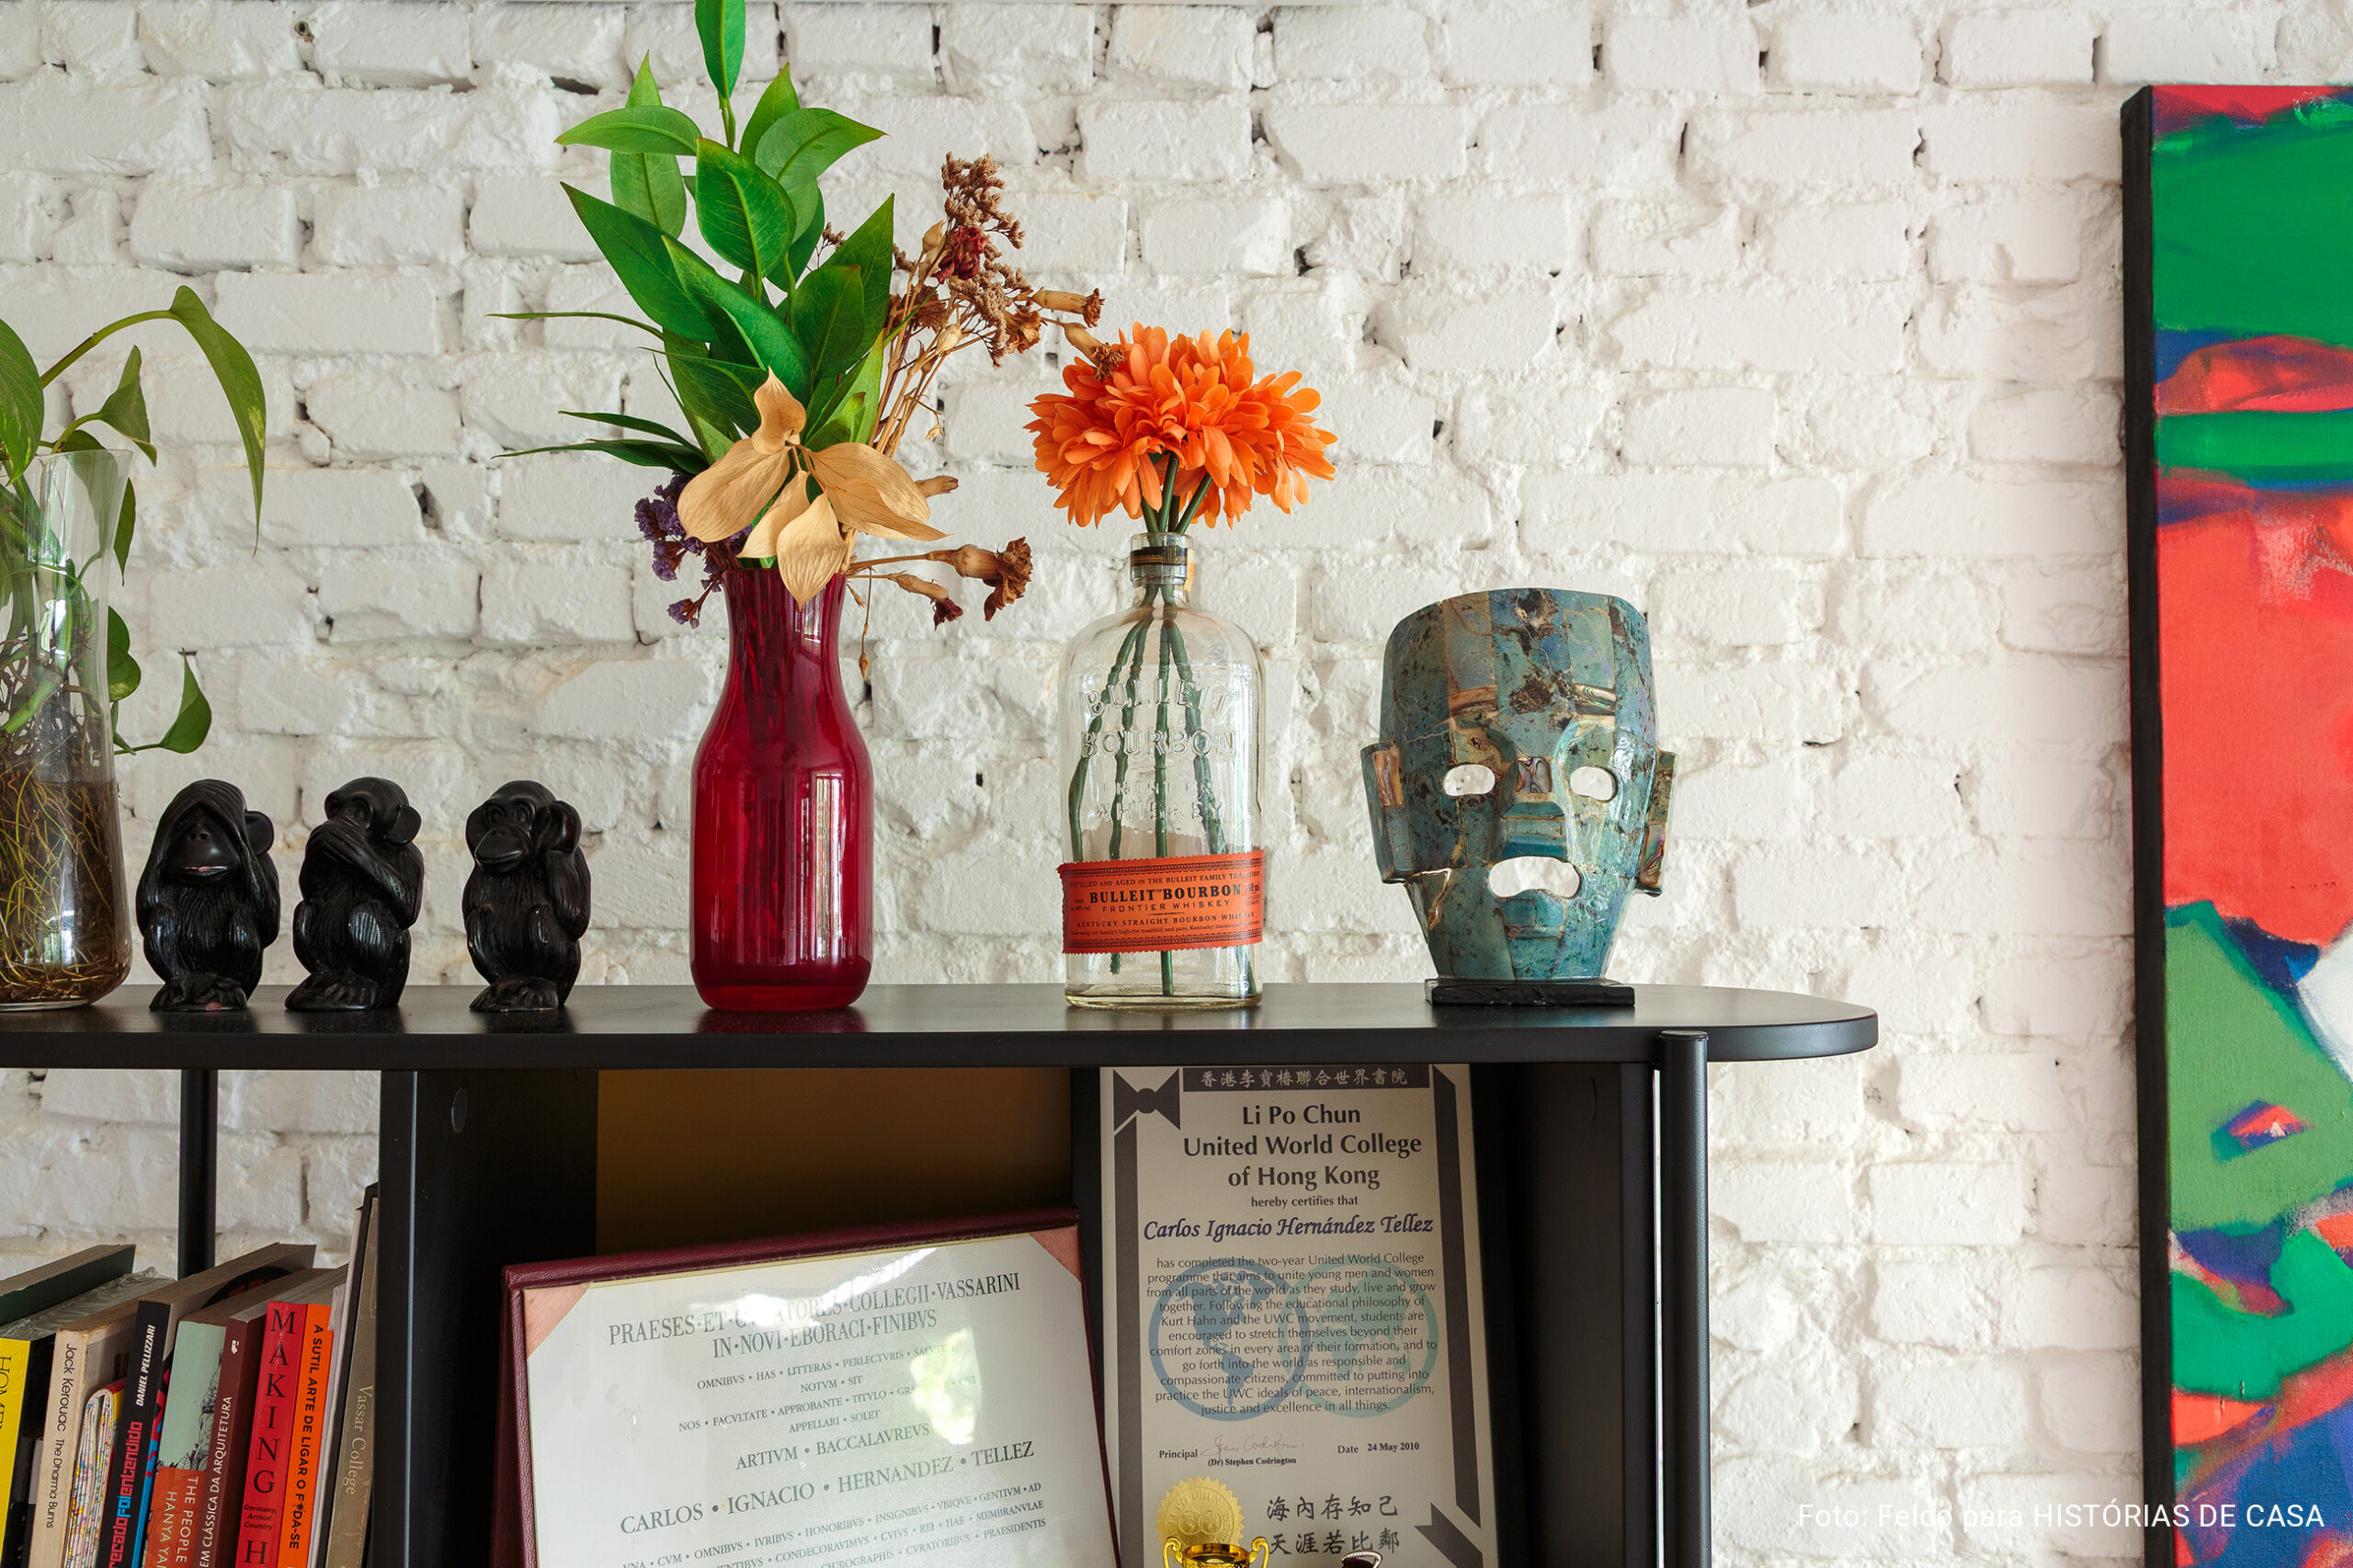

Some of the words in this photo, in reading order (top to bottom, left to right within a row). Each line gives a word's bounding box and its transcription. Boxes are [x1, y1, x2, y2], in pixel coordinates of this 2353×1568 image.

[1081, 730, 1236, 757] BOURBON
[1165, 875, 1198, 883] BULLEIT
[1199, 873, 1227, 881] FAMILY
[1090, 889, 1155, 903] BULLEIT
[1162, 883, 1241, 900] BOURBON
[1102, 903, 1167, 913] FRONTIER
[1172, 899, 1231, 910] WHISKEY
[1122, 917, 1169, 926] STRAIGHT
[1173, 915, 1218, 924] BOURBON
[1244, 1105, 1260, 1125] Li
[1269, 1106, 1295, 1125] Po
[1303, 1103, 1360, 1125] Chun
[1184, 1135, 1257, 1156] United
[1266, 1133, 1333, 1154] World
[1341, 1132, 1421, 1159] College
[1228, 1165, 1250, 1187] of
[1258, 1166, 1317, 1191] Hong
[1325, 1165, 1380, 1190] Kong
[1251, 1196, 1288, 1210] hereby
[1291, 1195, 1334, 1206] certifies
[1337, 1195, 1358, 1206] that
[1144, 1219, 1200, 1240] Carlos
[1206, 1218, 1272, 1244] Ignacio
[1277, 1215, 1375, 1236] Hernández
[1381, 1214, 1433, 1233] Tellez
[1157, 1257, 1175, 1267] has
[1178, 1256, 1234, 1270] completed
[1238, 1256, 1255, 1267] the
[1258, 1256, 1305, 1269] two-year
[1309, 1255, 1344, 1265] United
[1347, 1254, 1381, 1264] World
[1384, 1253, 1424, 1267] College
[1148, 1274, 1210, 1286] programme
[1212, 1270, 1234, 1281] that
[1234, 1271, 1261, 1280] aims
[1265, 1271, 1275, 1280] to
[1279, 1270, 1305, 1279] unite
[1308, 1271, 1341, 1282] young
[1345, 1270, 1368, 1278] men
[1371, 1267, 1391, 1278] and
[1395, 1269, 1434, 1278] women
[608, 1314, 696, 1346] PRAESES
[703, 1310, 727, 1334] ET
[849, 1284, 930, 1313] COLLEGII
[936, 1272, 1021, 1301] VASSARINI
[314, 1324, 324, 1334] A
[713, 1336, 732, 1358] IN
[741, 1329, 783, 1354] NOVI
[790, 1318, 866, 1347] EBORACI
[873, 1309, 937, 1335] FINIBVS
[63, 1343, 77, 1374] Jack
[141, 1324, 155, 1373] PELLIZZARI
[309, 1337, 323, 1373] SUTIL
[698, 1374, 745, 1391] OMNIBVS
[756, 1369, 776, 1381] HAS
[788, 1361, 832, 1377] LITTERAS
[843, 1351, 904, 1368] PERLECTVRIS
[801, 1379, 837, 1393] NOTVM
[848, 1375, 862, 1386] SIT
[136, 1375, 148, 1407] DANIEL
[305, 1377, 317, 1412] ARTE
[1155, 1391, 1199, 1403] practice
[1202, 1389, 1219, 1399] the
[1223, 1388, 1253, 1399] UWC
[1257, 1387, 1289, 1398] ideals
[1292, 1387, 1302, 1397] of
[1306, 1389, 1341, 1400] peace,
[1346, 1383, 1434, 1397] internationalism,
[57, 1379, 74, 1432] Kerouac
[354, 1385, 373, 1433] Vassar
[679, 1419, 700, 1433] NOS
[713, 1408, 767, 1426] FACVLTATE
[778, 1397, 842, 1416] APPROBANTE
[852, 1390, 886, 1404] TITVLO
[1201, 1404, 1236, 1417] justice
[1240, 1403, 1259, 1414] and
[1264, 1402, 1321, 1413] excellence
[1325, 1403, 1335, 1412] in
[1339, 1401, 1351, 1411] all
[1356, 1400, 1390, 1414] things.
[302, 1415, 313, 1433] DE
[790, 1415, 839, 1433] APPELLARI
[851, 1409, 880, 1423] SOLET
[53, 1438, 65, 1456] The
[213, 1396, 233, 1475] ARQUITETURA
[736, 1446, 798, 1471] ARTIVM
[817, 1423, 929, 1456] BACCALAVREVS
[1338, 1445, 1358, 1454] Date
[1368, 1442, 1377, 1451] 24
[1380, 1442, 1398, 1453] May
[1401, 1441, 1419, 1450] 2010
[297, 1437, 311, 1475] LIGAR
[343, 1437, 367, 1494] College
[1159, 1449, 1198, 1460] Principal
[1208, 1458, 1223, 1467] (Dr)
[1225, 1458, 1254, 1468] Stephen
[1256, 1457, 1296, 1465] Codrington
[48, 1458, 63, 1499] Dharma
[184, 1476, 199, 1505] THE
[210, 1477, 221, 1494] DA
[296, 1480, 306, 1490] O
[620, 1503, 703, 1535] CARLOS
[728, 1483, 814, 1515] IGNACIO
[838, 1456, 953, 1494] HERNANDEZ
[972, 1440, 1034, 1467] TELLEZ
[46, 1501, 58, 1528] Bums
[160, 1491, 177, 1542] HANYA
[202, 1496, 218, 1548] CLÁSSICA
[244, 1505, 278, 1514] Germany,
[247, 1513, 273, 1522] Arrival
[176, 1510, 194, 1562] PEOPLE
[244, 1521, 273, 1530] Country
[657, 1552, 681, 1566] CVM
[694, 1541, 743, 1560] OMNIBVS
[755, 1530, 793, 1548] IVRIBVS
[805, 1517, 864, 1538] HONORIBVS
[876, 1504, 928, 1523] INSIGNIBVS
[938, 1495, 972, 1510] VBIQVE
[979, 1486, 1021, 1502] GENTIVM
[1029, 1482, 1041, 1494] AD
[983, 1517, 1046, 1540] PRAESIDENTIS
